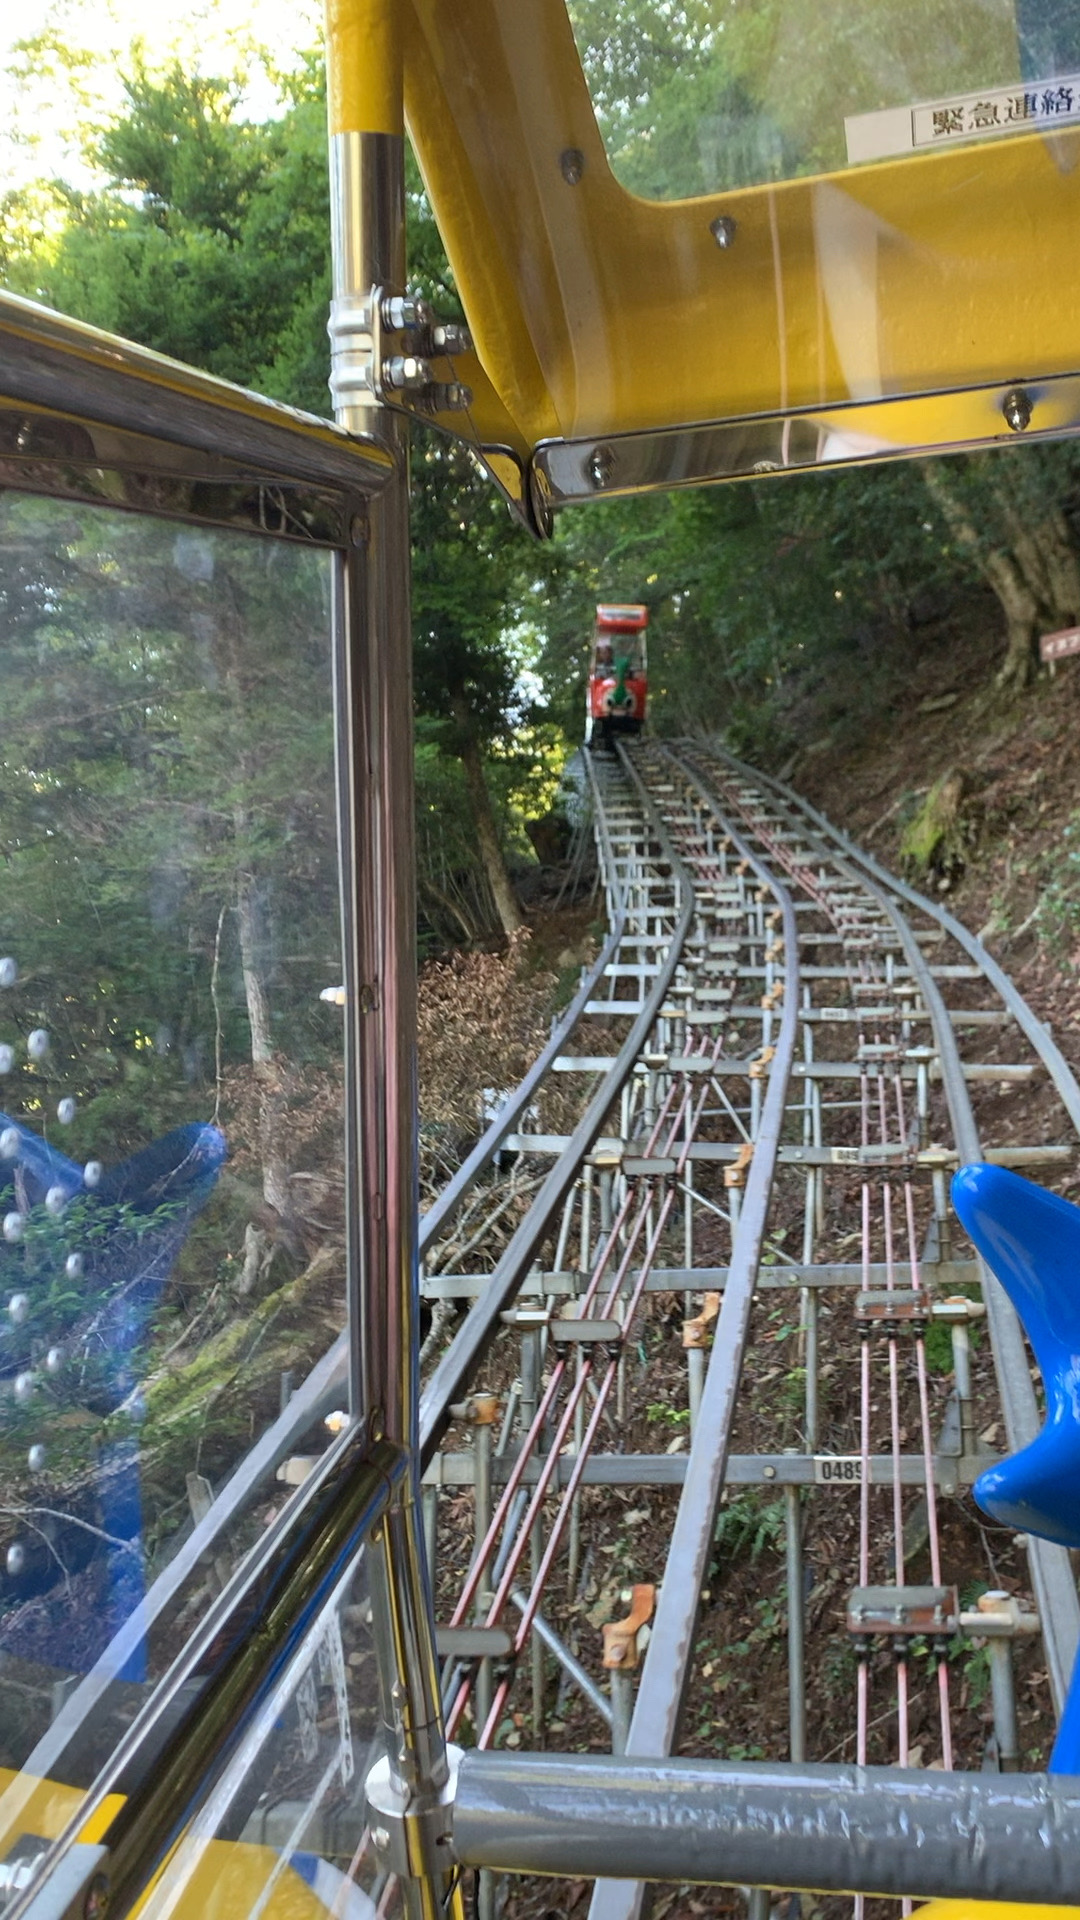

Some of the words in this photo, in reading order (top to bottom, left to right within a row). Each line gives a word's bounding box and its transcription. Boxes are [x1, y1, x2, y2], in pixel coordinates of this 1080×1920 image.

[932, 86, 1080, 137] 緊急連絡
[822, 1461, 862, 1480] 0489
